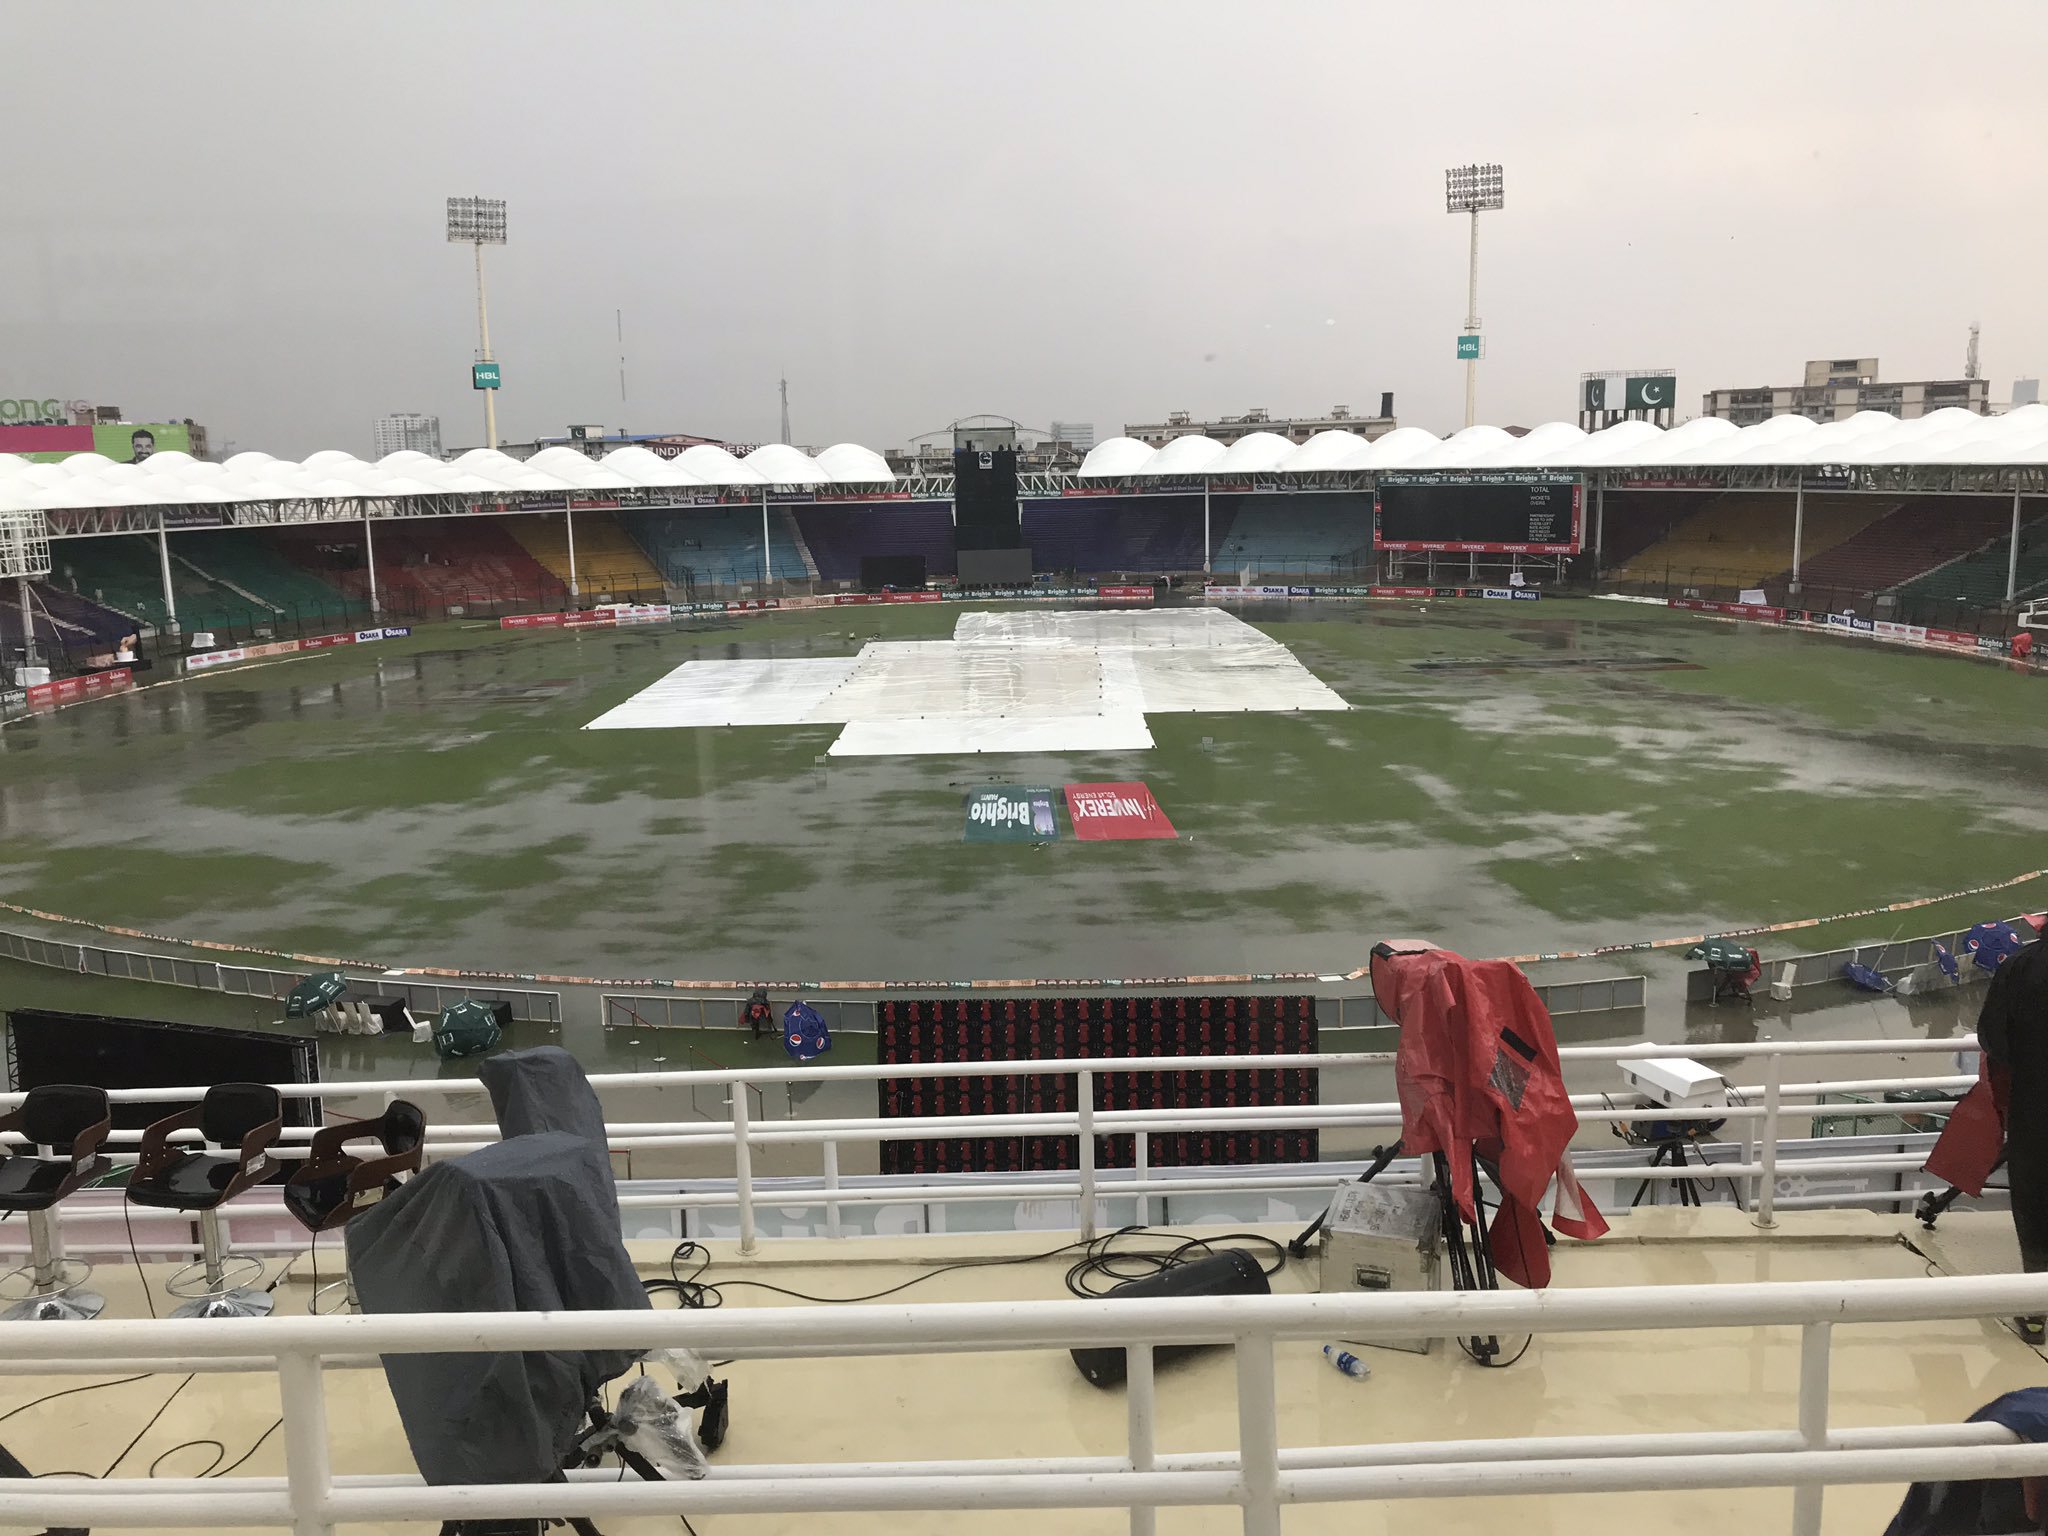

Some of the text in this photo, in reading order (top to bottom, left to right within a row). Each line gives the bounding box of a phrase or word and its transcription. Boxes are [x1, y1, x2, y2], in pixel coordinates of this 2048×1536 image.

[1978, 638, 2003, 647] Brighto
[4, 692, 25, 702] Brighto
[971, 797, 1030, 828] Brighto
[1075, 798, 1146, 819] INVEREX
